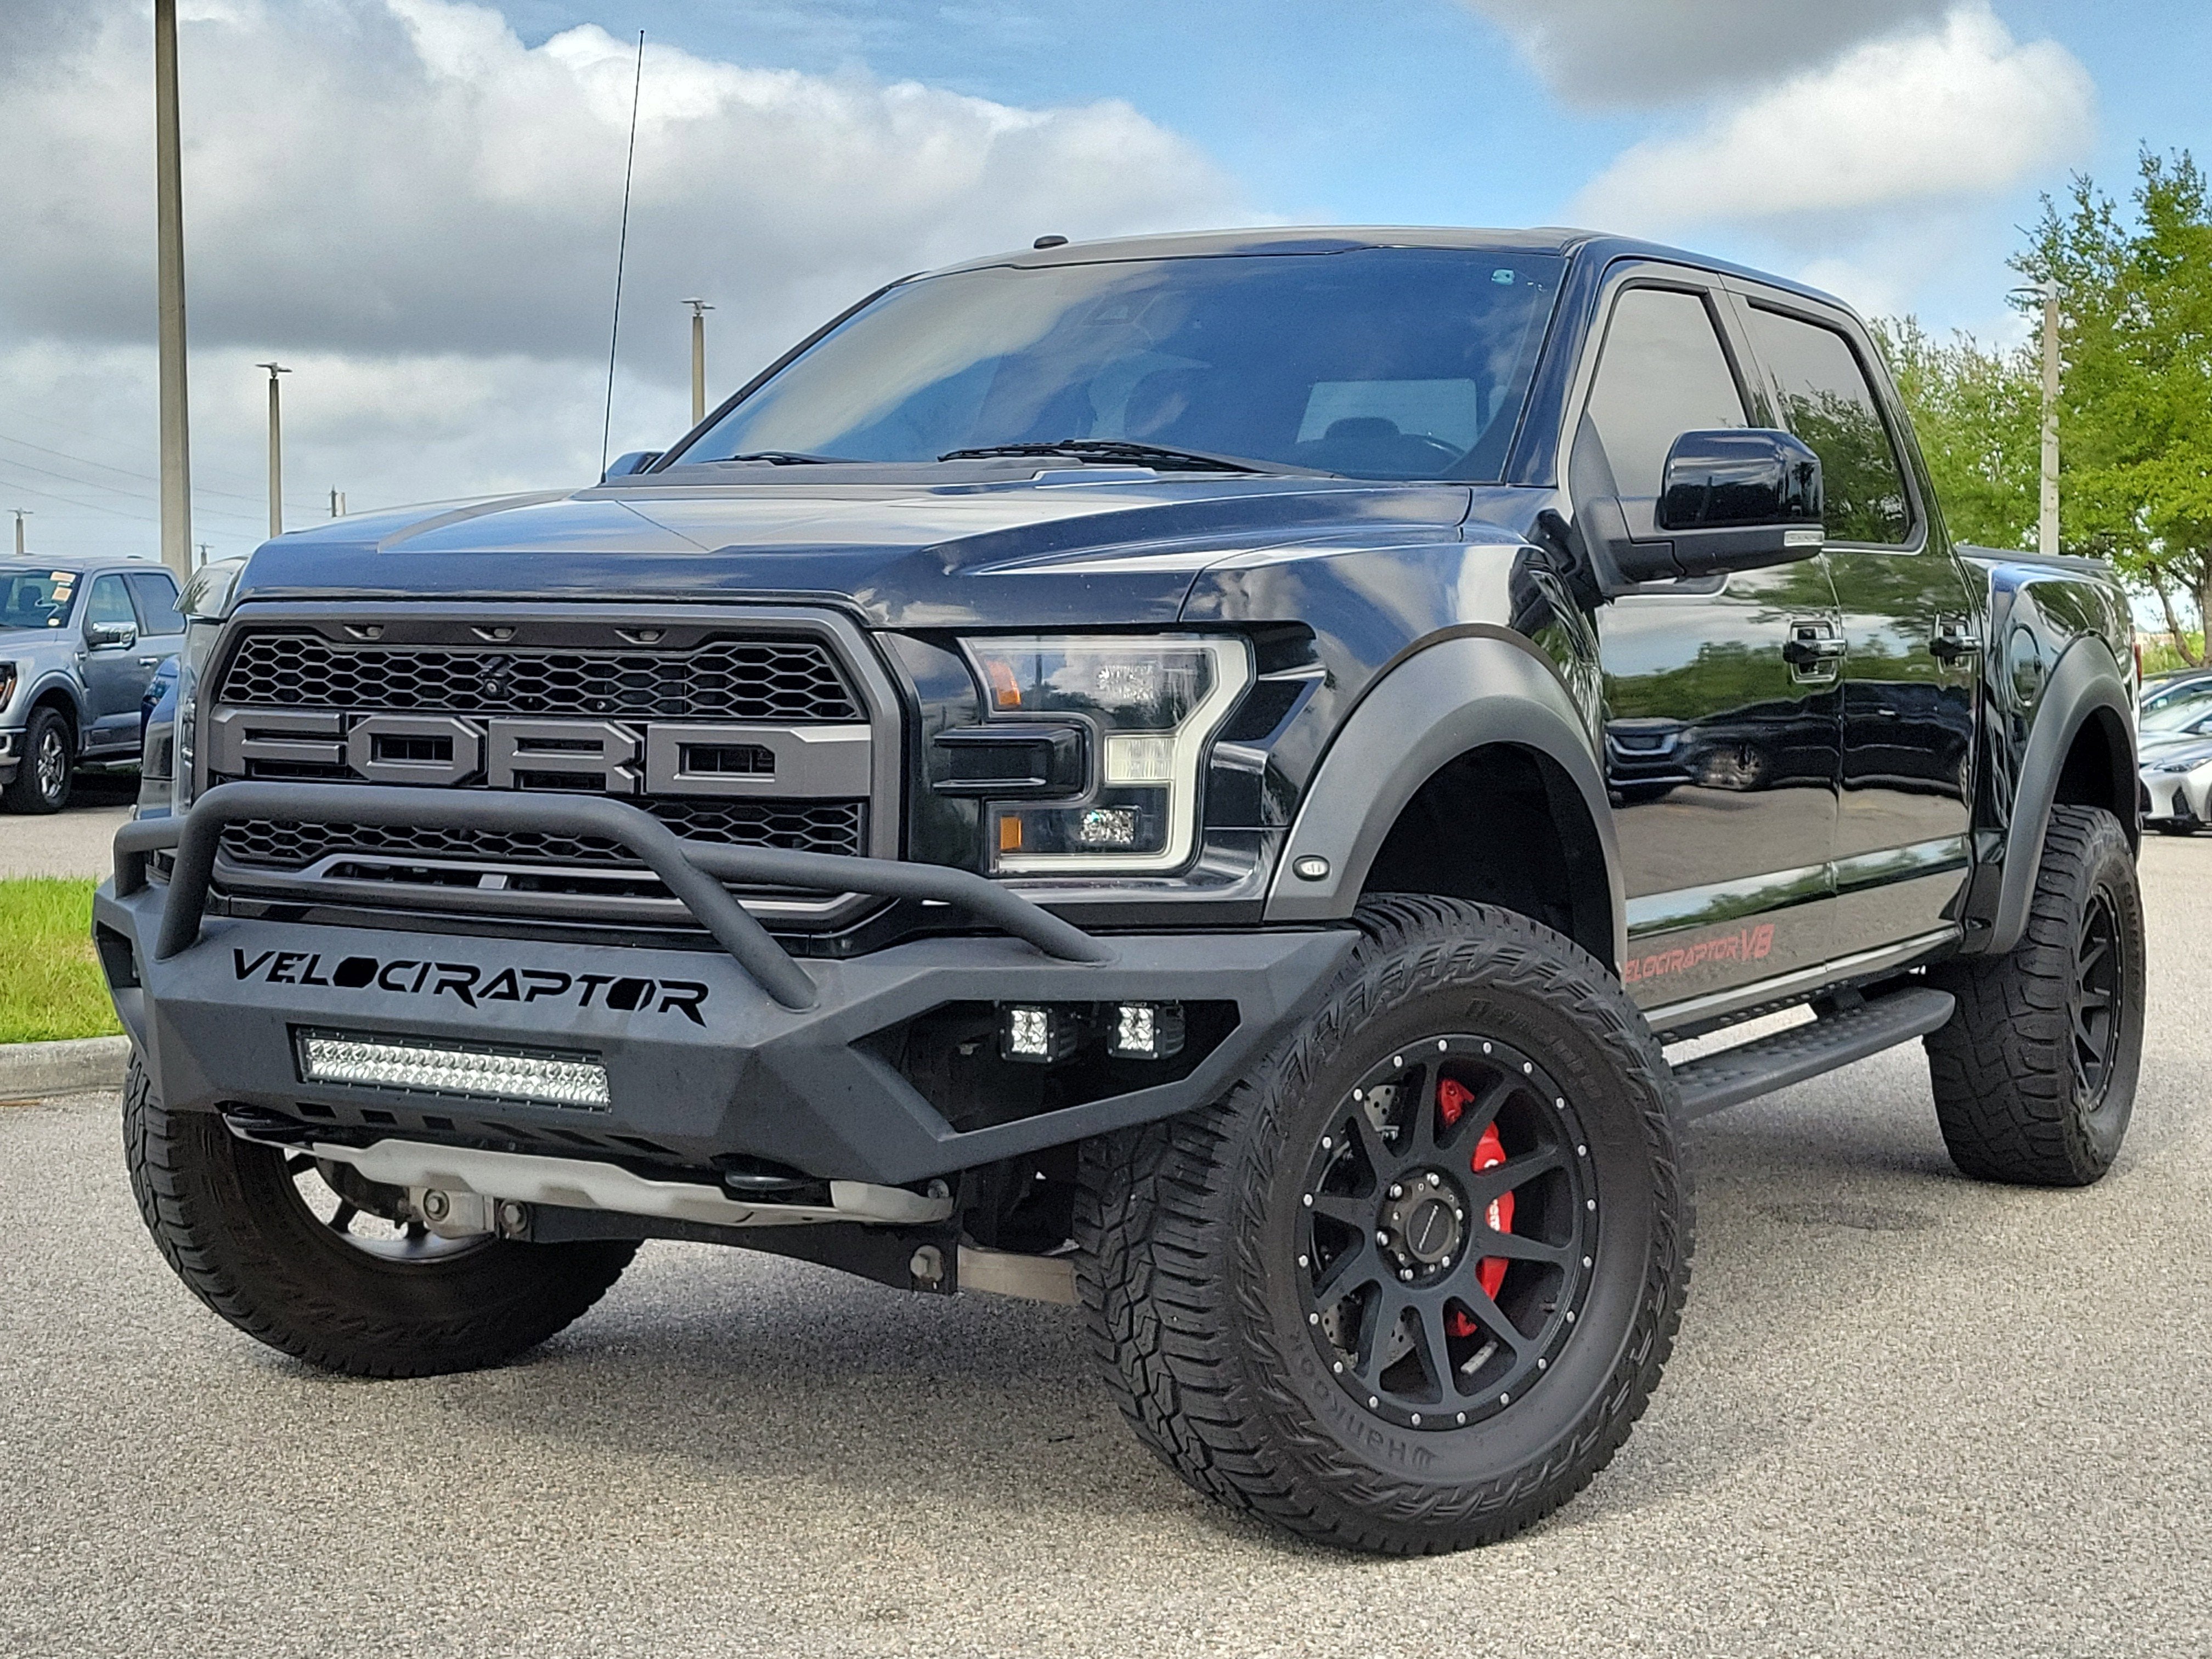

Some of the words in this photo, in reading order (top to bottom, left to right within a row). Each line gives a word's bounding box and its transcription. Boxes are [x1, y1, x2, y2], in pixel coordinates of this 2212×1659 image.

[209, 708, 871, 797] FORD
[233, 948, 708, 1028] VELOCIRAPTOR
[1625, 936, 1740, 983] ELOCIRAPTOR
